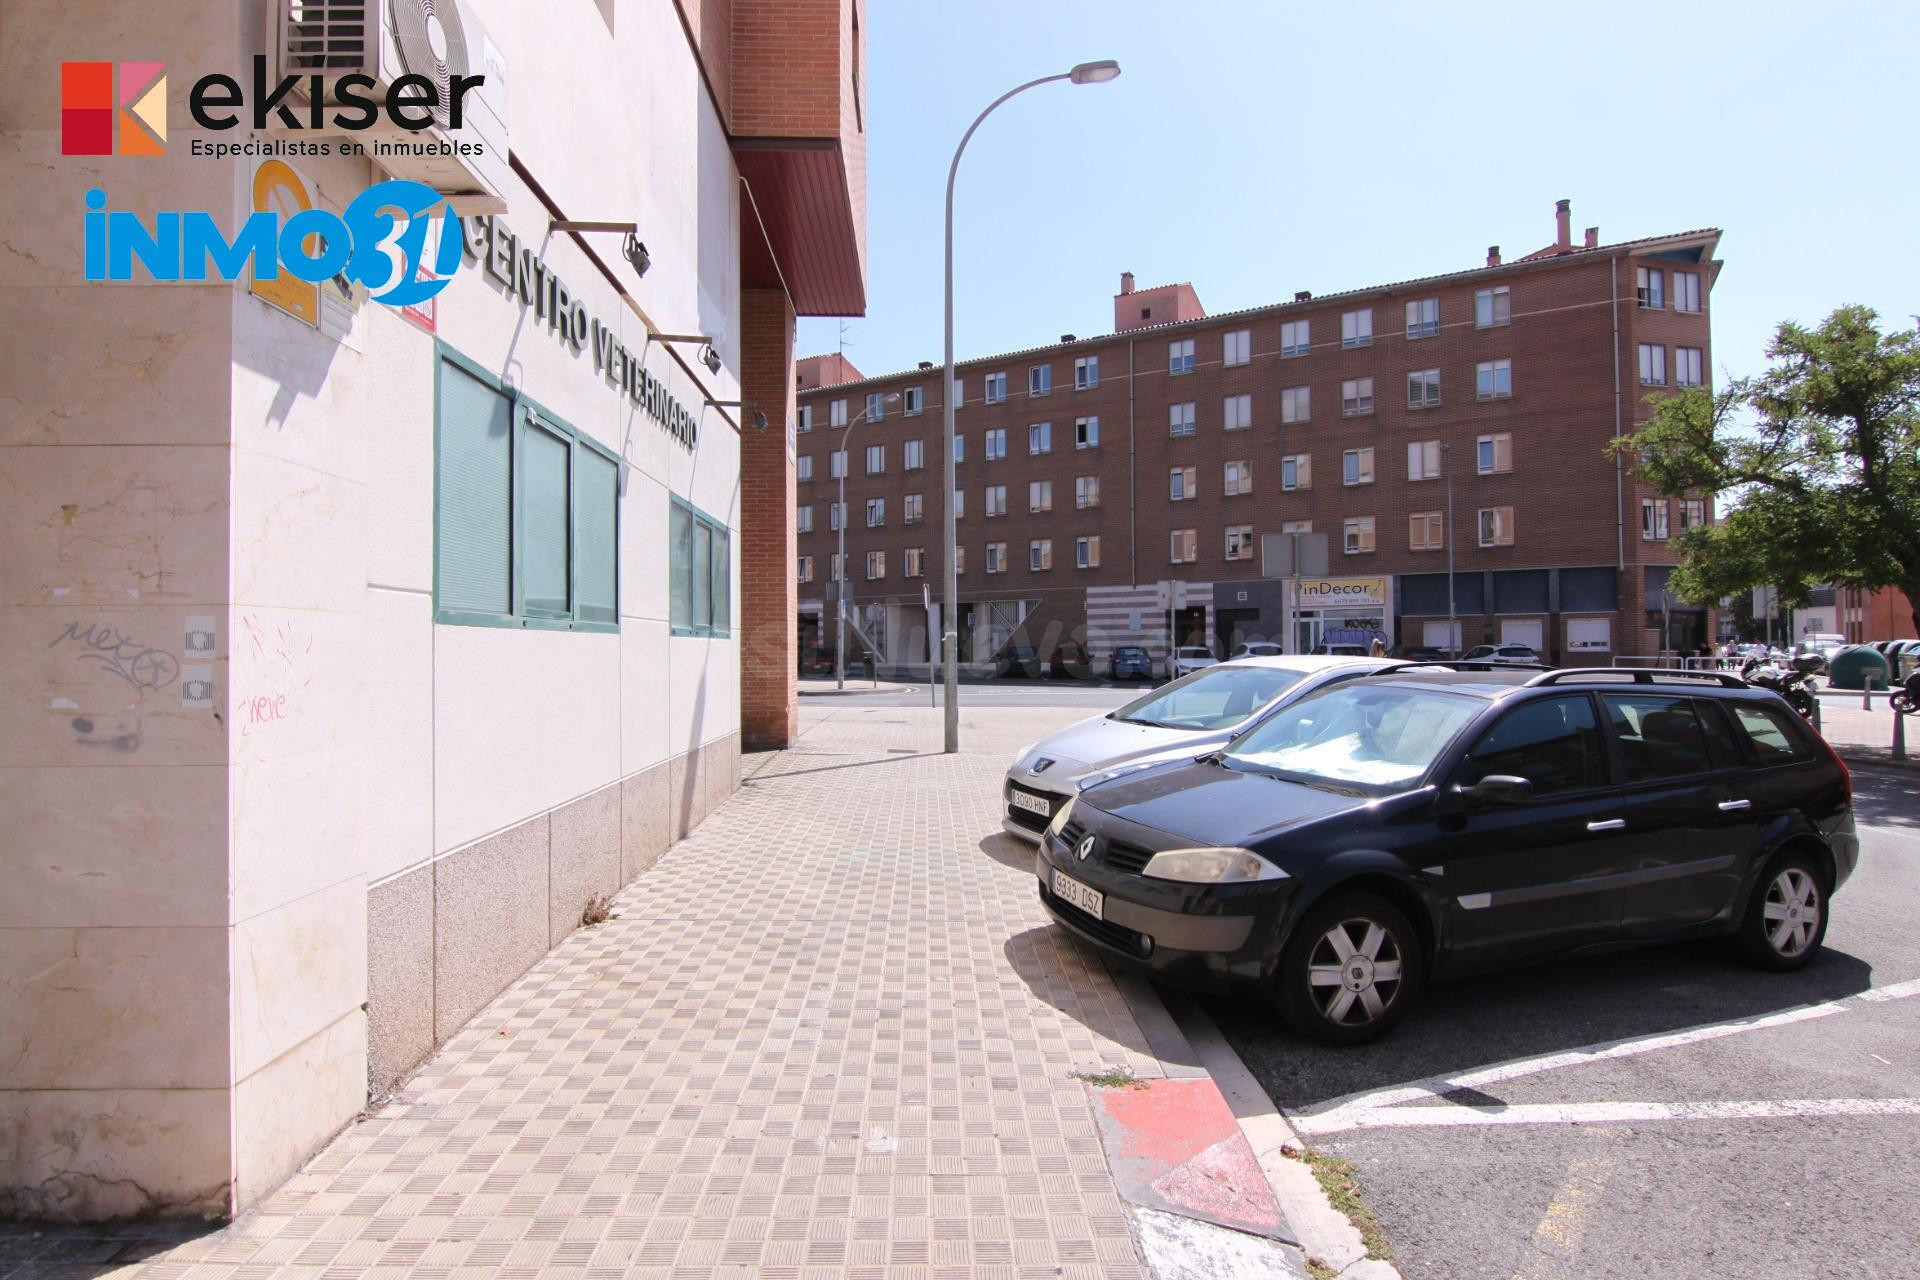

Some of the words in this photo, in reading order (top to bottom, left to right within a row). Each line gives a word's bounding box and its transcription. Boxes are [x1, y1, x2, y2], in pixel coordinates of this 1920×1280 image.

[462, 215, 590, 350] CENTRO
[591, 317, 698, 450] VETERINARIO
[1016, 793, 1033, 809] 3090
[1056, 875, 1077, 901] 9333
[1082, 888, 1099, 914] DSZ
